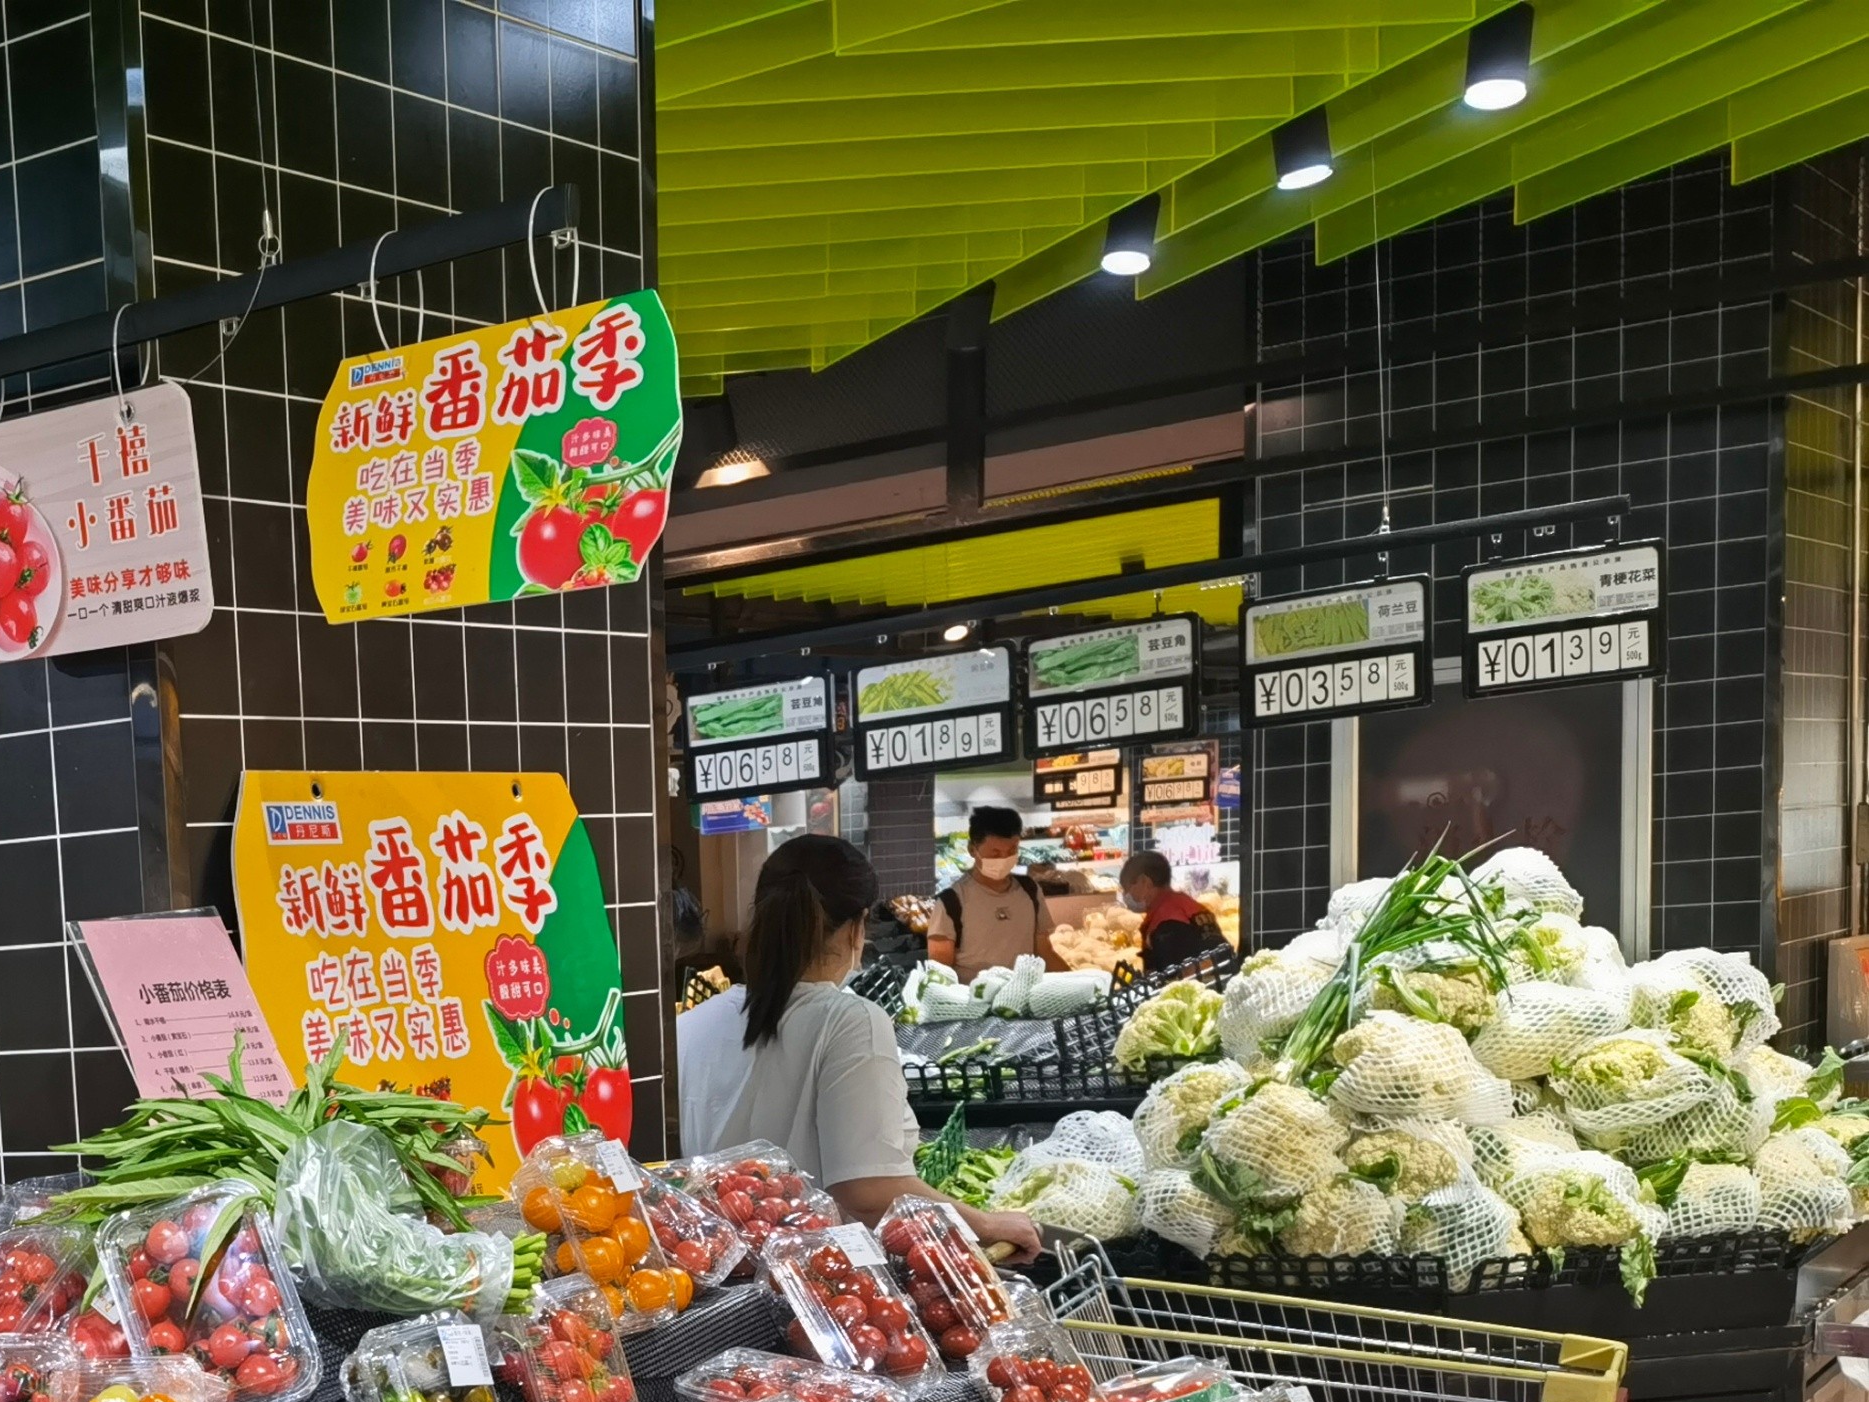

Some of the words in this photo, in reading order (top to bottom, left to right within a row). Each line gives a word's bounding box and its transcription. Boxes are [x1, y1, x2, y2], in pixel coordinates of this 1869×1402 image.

[332, 311, 639, 449] 新鲜番茄季
[77, 424, 150, 484] 千禧
[359, 444, 479, 490] 吃在当季
[68, 485, 179, 549] 小番茄
[346, 478, 491, 532] 美味又实惠
[69, 559, 192, 599] 美味分享才够味
[1599, 566, 1657, 589] 青梗花菜
[1377, 600, 1418, 618] 荷兰豆
[1147, 634, 1187, 653] 芸豆角
[284, 805, 335, 820] DENNIS
[280, 819, 553, 931] 新鲜番茄季
[138, 978, 232, 1005] 小番茄价格表
[310, 945, 439, 1004] 吃在当季
[305, 1001, 465, 1062] 美味又实惠
